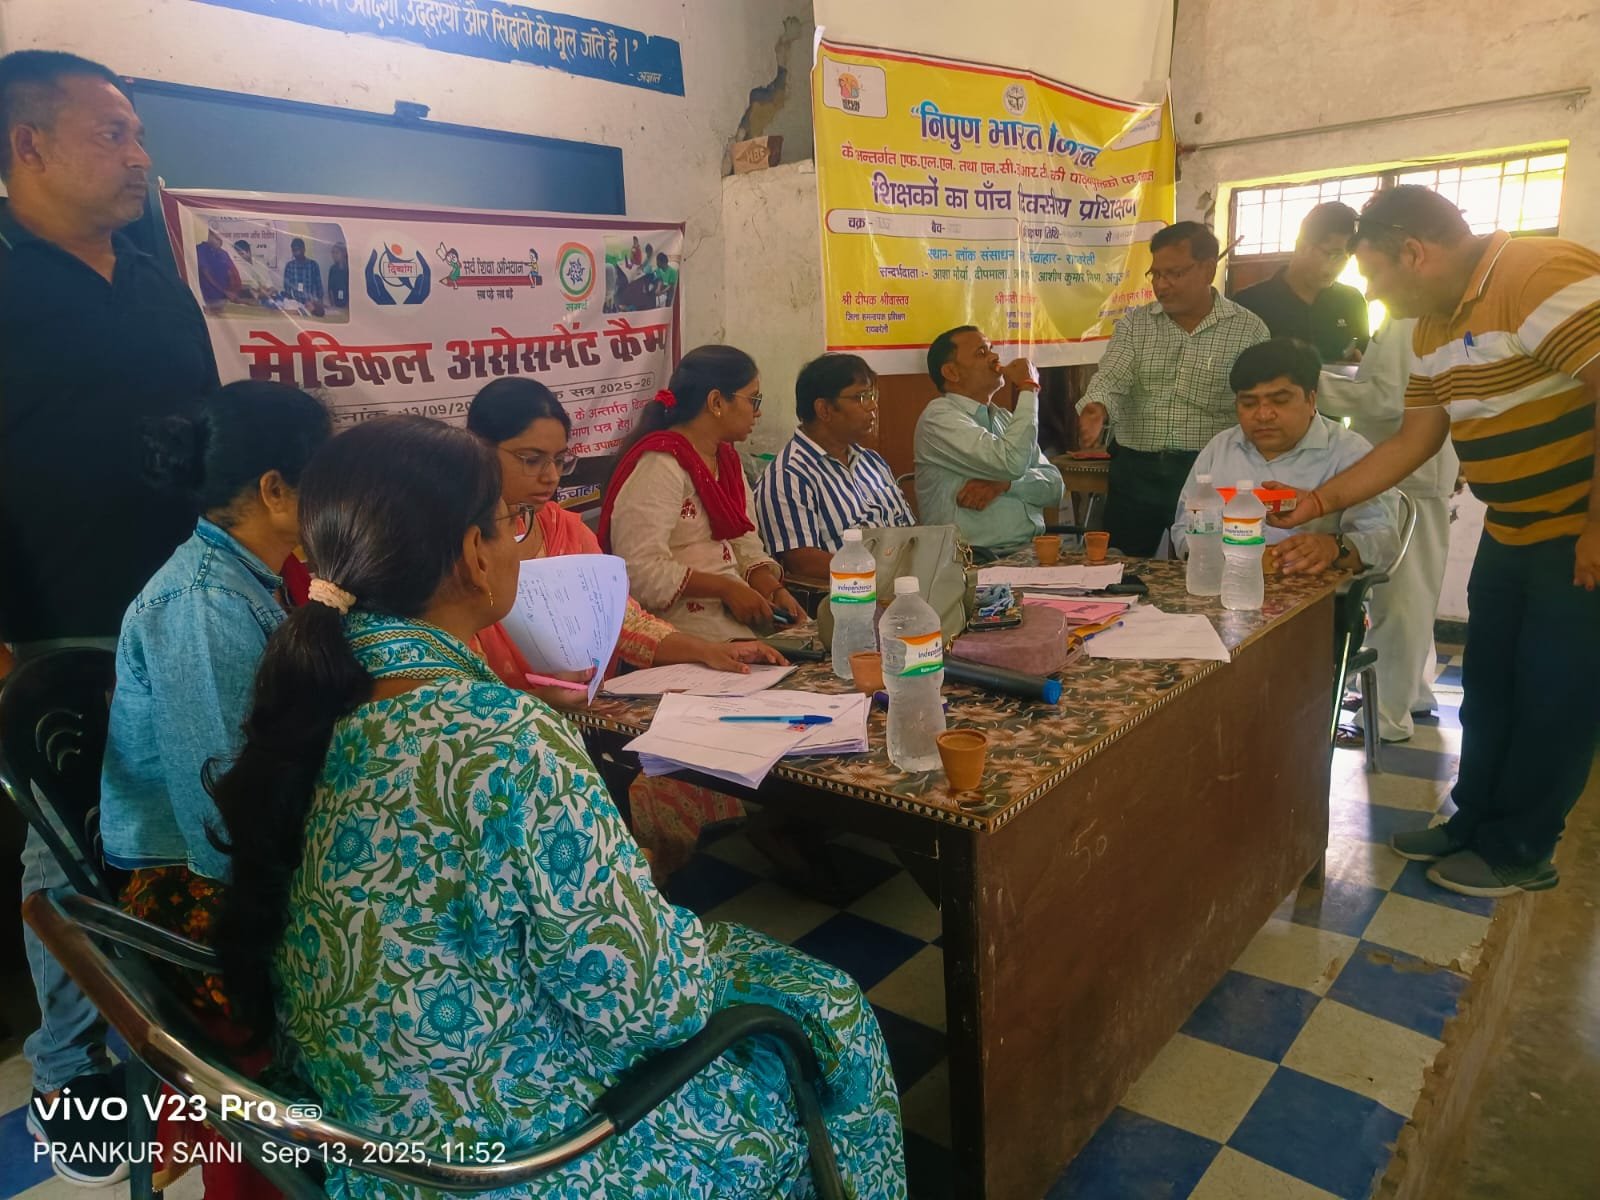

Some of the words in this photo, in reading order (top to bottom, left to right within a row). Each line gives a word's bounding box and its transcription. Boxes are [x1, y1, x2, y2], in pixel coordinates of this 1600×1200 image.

[463, 3, 492, 42] और
[535, 15, 550, 52] को
[553, 25, 577, 64] भूल
[580, 27, 606, 59] जाते
[989, 119, 1043, 151] भारत
[841, 141, 854, 158] के
[855, 147, 896, 165] अन्तर्गत
[900, 153, 955, 171] एफ.एल.एन.
[959, 160, 977, 173] तथा
[1050, 166, 1065, 182] की
[1121, 176, 1137, 186] पर
[873, 171, 940, 208] शिक्षकों
[945, 184, 969, 209] का
[974, 179, 1011, 211] पाँच
[1079, 193, 1137, 222] प्रशिक्षण
[848, 217, 866, 230] चक्र
[980, 247, 1015, 262] संसाधन
[463, 257, 476, 275] सर्व
[477, 257, 494, 275] शिक्षा
[496, 257, 524, 275] अभियान
[1064, 271, 1084, 286] कुमार
[842, 291, 852, 306] श्री
[855, 291, 877, 306] दीपक
[880, 291, 910, 306] श्रीवास्तव
[240, 330, 435, 388] मेडिकल
[446, 322, 600, 380] असेसमेंट
[569, 384, 595, 398] सत्र
[600, 377, 652, 394] 2025-26
[575, 407, 585, 421] के
[589, 401, 628, 419] अन्तर्गत
[594, 422, 612, 434] पत्र
